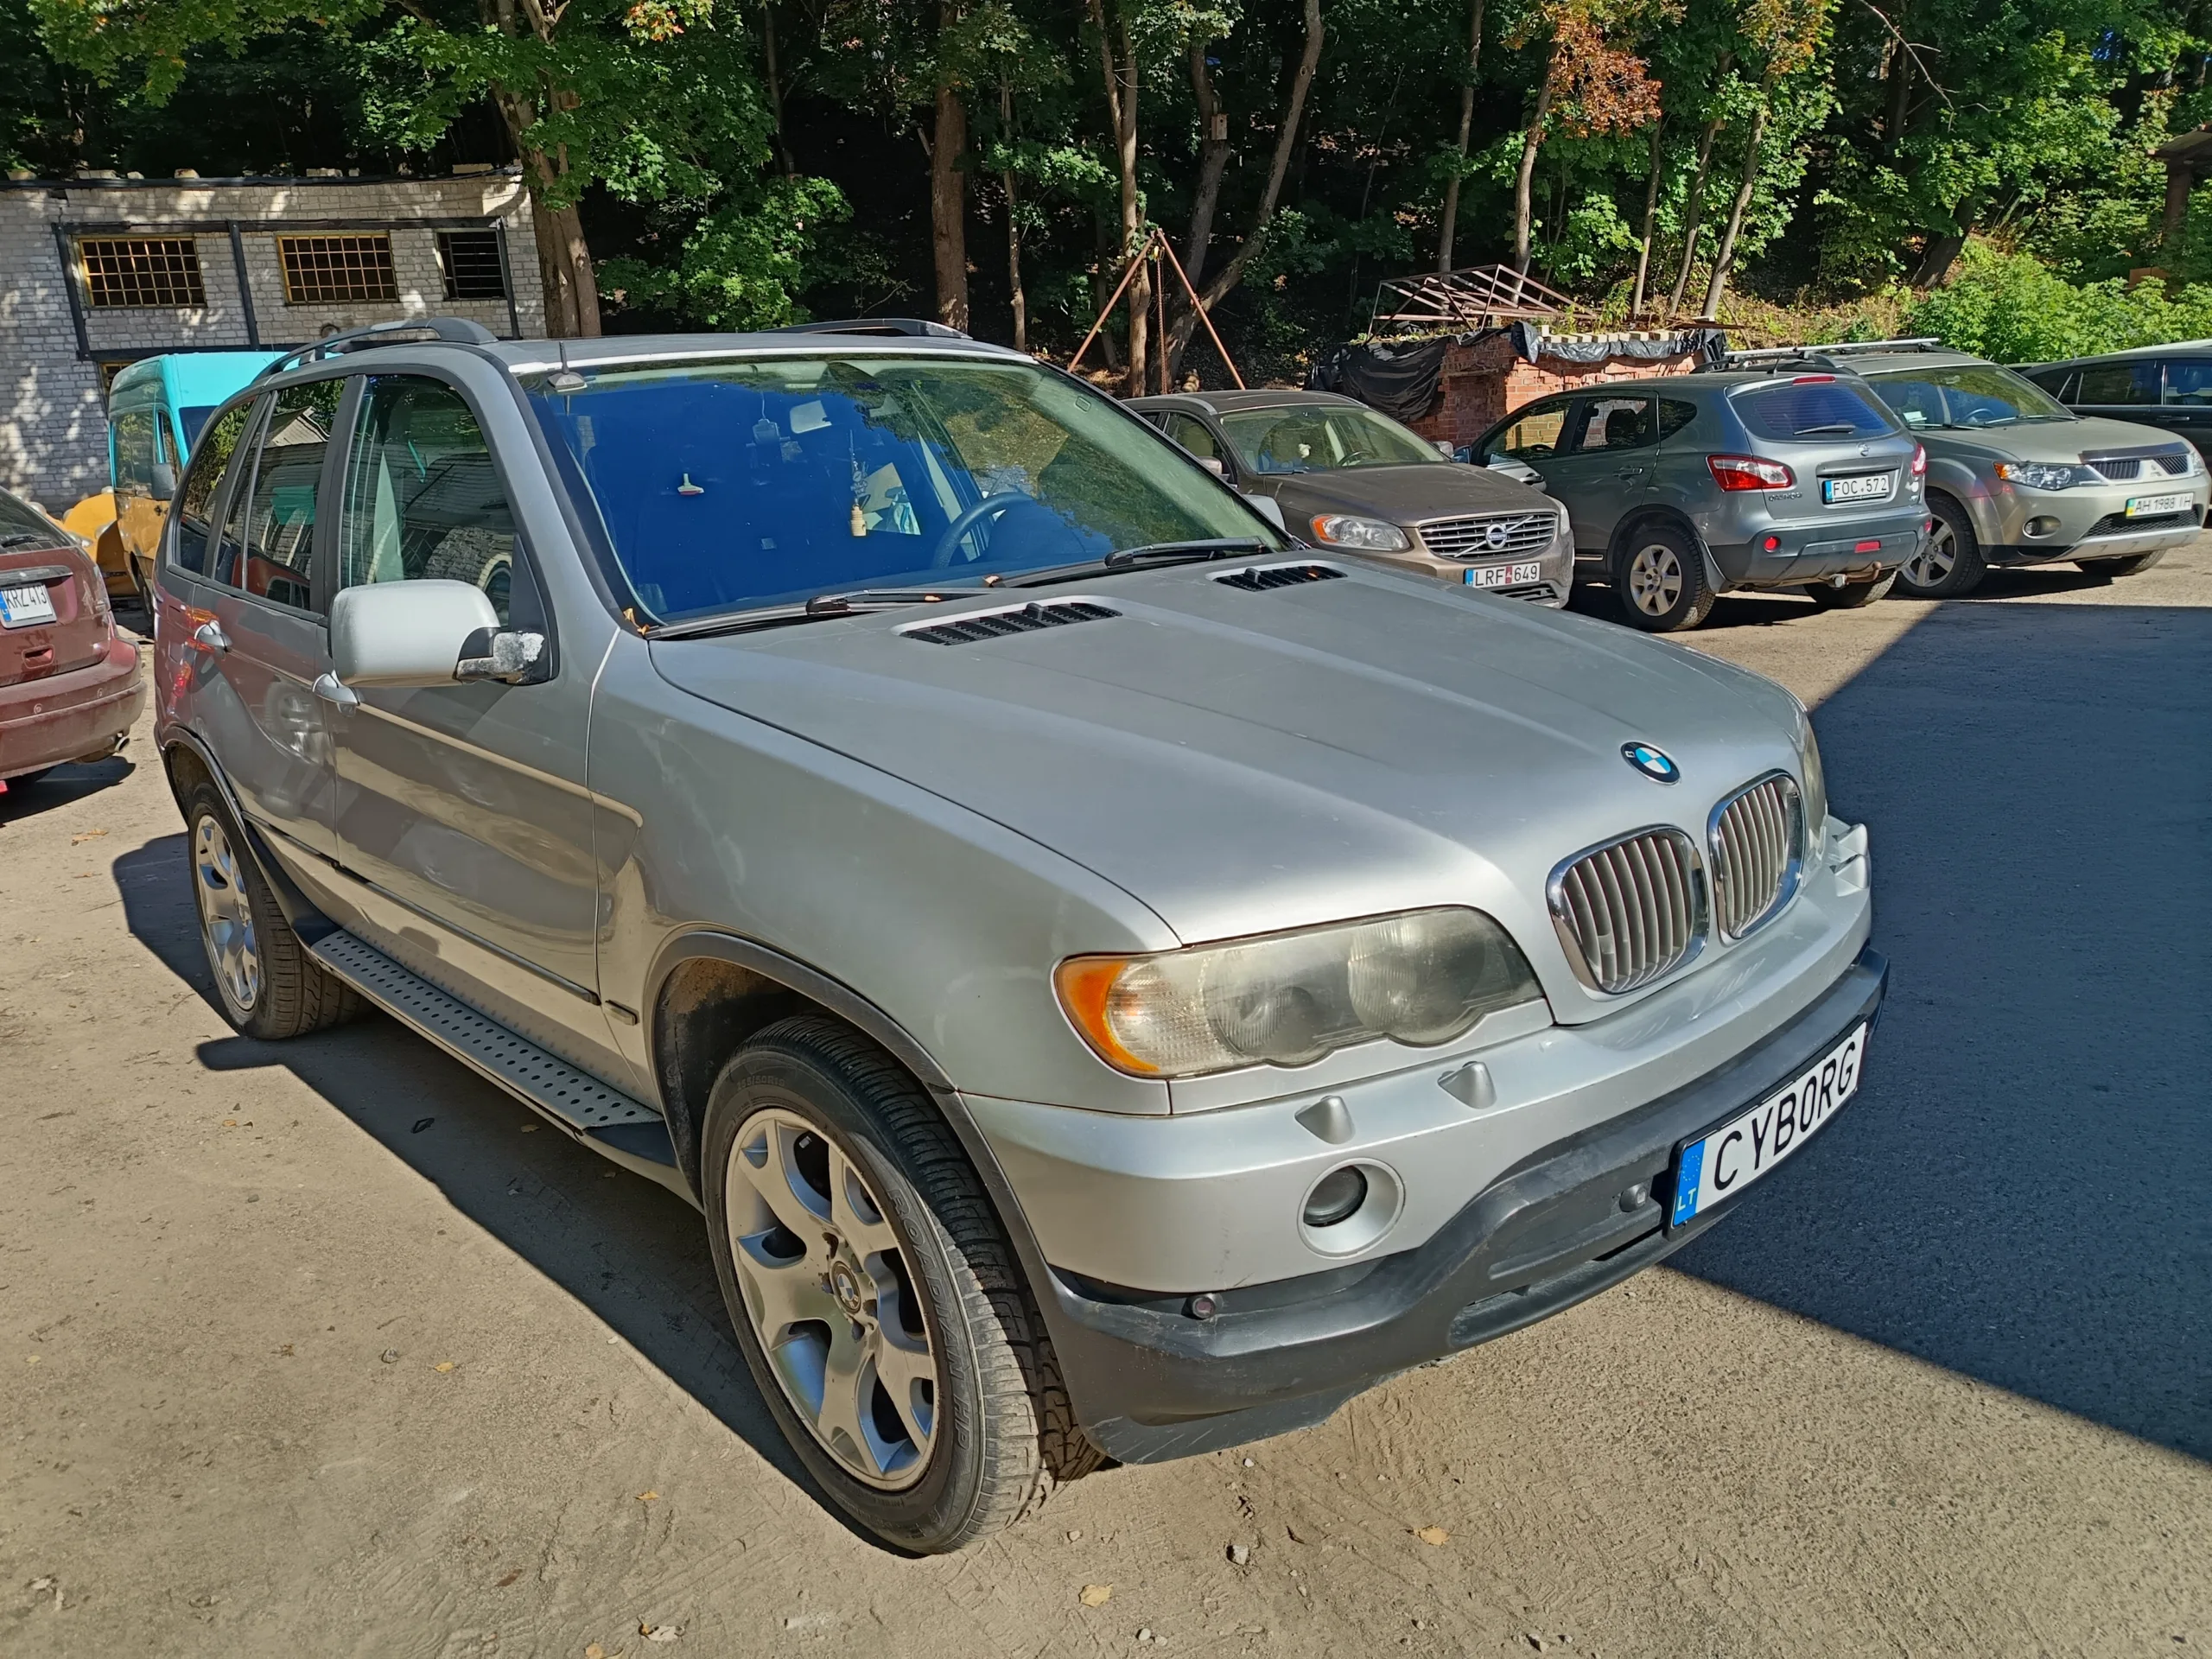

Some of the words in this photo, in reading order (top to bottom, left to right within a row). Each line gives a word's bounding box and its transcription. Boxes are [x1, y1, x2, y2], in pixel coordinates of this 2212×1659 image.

[1834, 480, 1858, 496] FOC
[1866, 478, 1886, 493] 572
[2135, 499, 2152, 512] AH
[1475, 569, 1504, 587] LRF
[1514, 565, 1537, 582] 649
[3, 588, 29, 609] KRZ
[1713, 1041, 1856, 1191] CYBORG
[1677, 1187, 1697, 1212] LT
[886, 1189, 965, 1382] ROADIAN
[952, 1392, 970, 1452] HP
